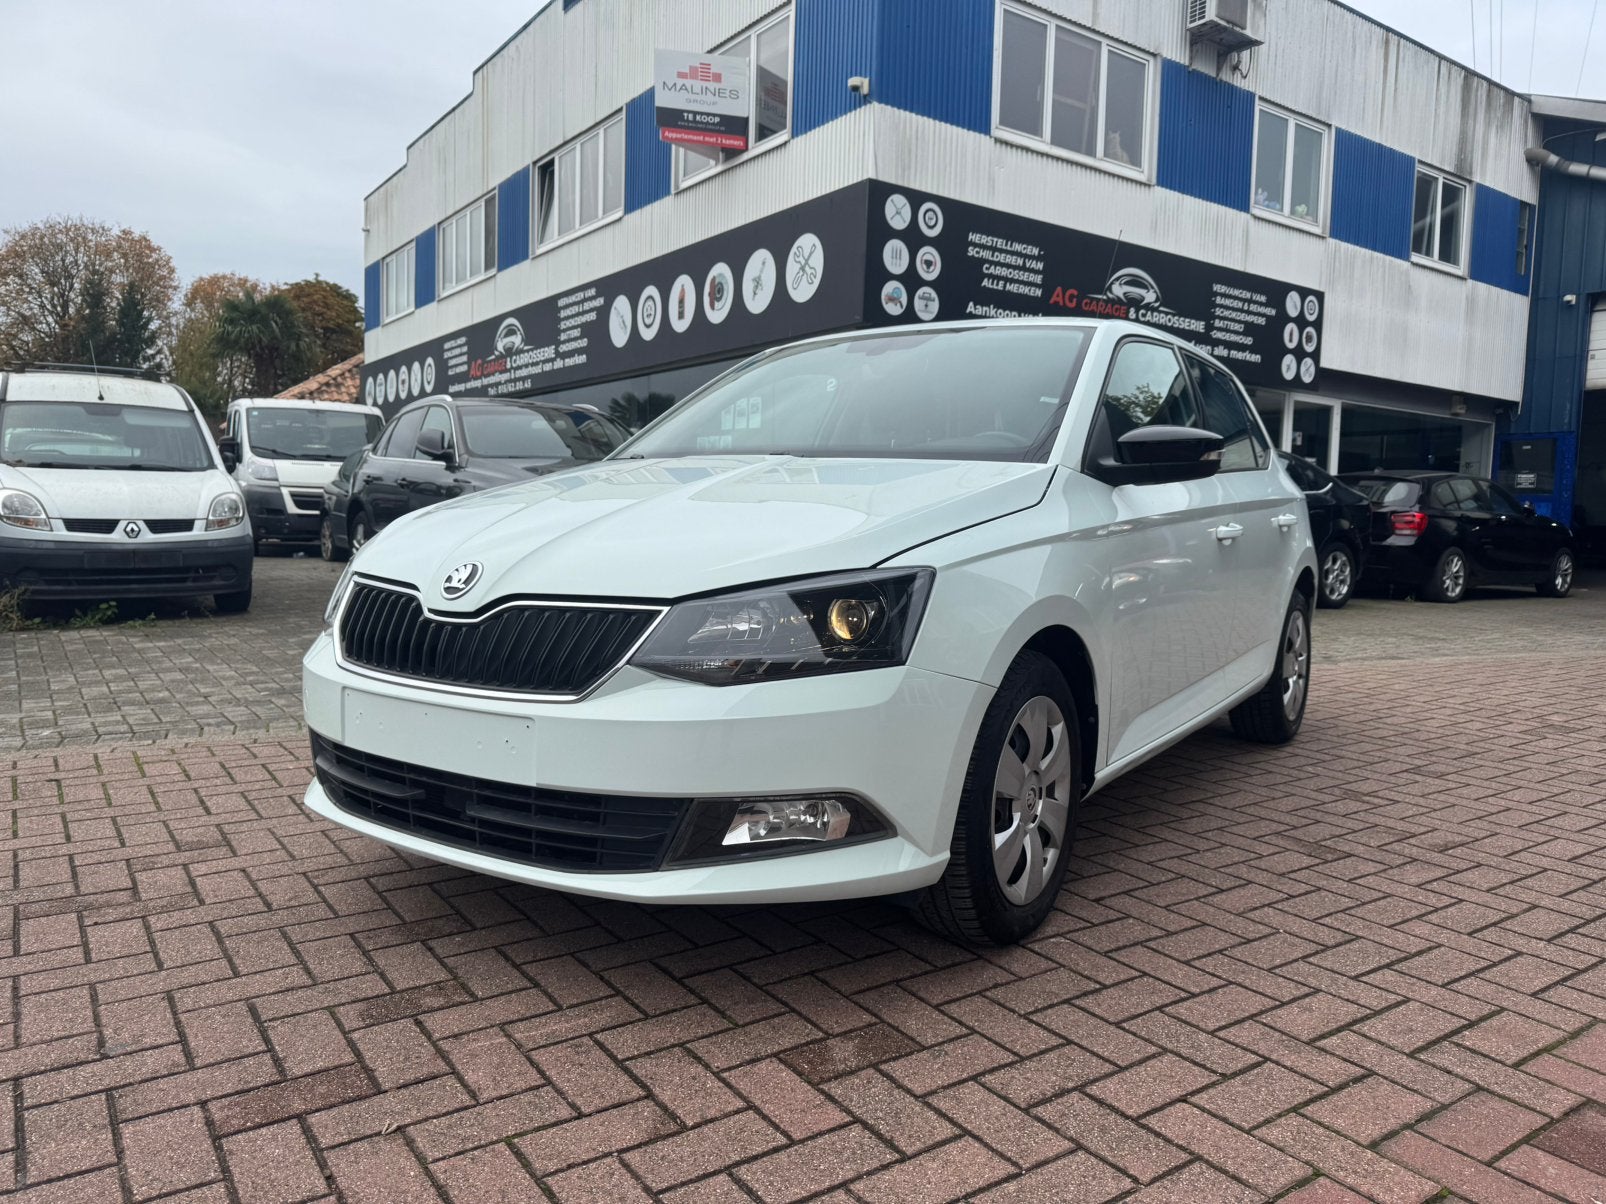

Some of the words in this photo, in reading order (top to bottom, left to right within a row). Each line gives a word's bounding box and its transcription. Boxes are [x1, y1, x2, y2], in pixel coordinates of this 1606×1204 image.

[662, 81, 740, 100] MALINES
[685, 97, 718, 106] GROUP
[683, 113, 694, 121] TE
[696, 114, 720, 123] KOOP
[664, 131, 704, 141] Appartement
[722, 138, 744, 146] kamers
[968, 231, 1040, 256] HERSTELLINGEN
[967, 246, 1024, 267] SCHILDEREN
[1025, 258, 1044, 271] VAN
[982, 263, 1043, 284] CARROSSERIE
[981, 277, 1005, 290] ALLE
[1005, 282, 1042, 297] MERKEN
[1212, 283, 1252, 299] VERVANGEN
[1049, 286, 1079, 308] AG
[1082, 298, 1127, 318] GARAGE
[1128, 307, 1136, 320] &
[1138, 309, 1205, 332] CARROSSERIE
[1215, 295, 1243, 308] BANDEN
[1243, 302, 1248, 310] &
[1249, 303, 1276, 316] REMMEN
[1214, 307, 1266, 325] SCHOKDEMPERS
[469, 359, 482, 378] AG
[482, 358, 505, 374] GARAGE
[506, 357, 511, 369] &
[511, 345, 556, 367] CARROSSERIE
[1213, 345, 1229, 357] alle
[1229, 350, 1261, 363] merken
[514, 362, 542, 378] onderhoud
[542, 362, 552, 371] van
[553, 357, 563, 369] alle
[564, 353, 587, 367] merken
